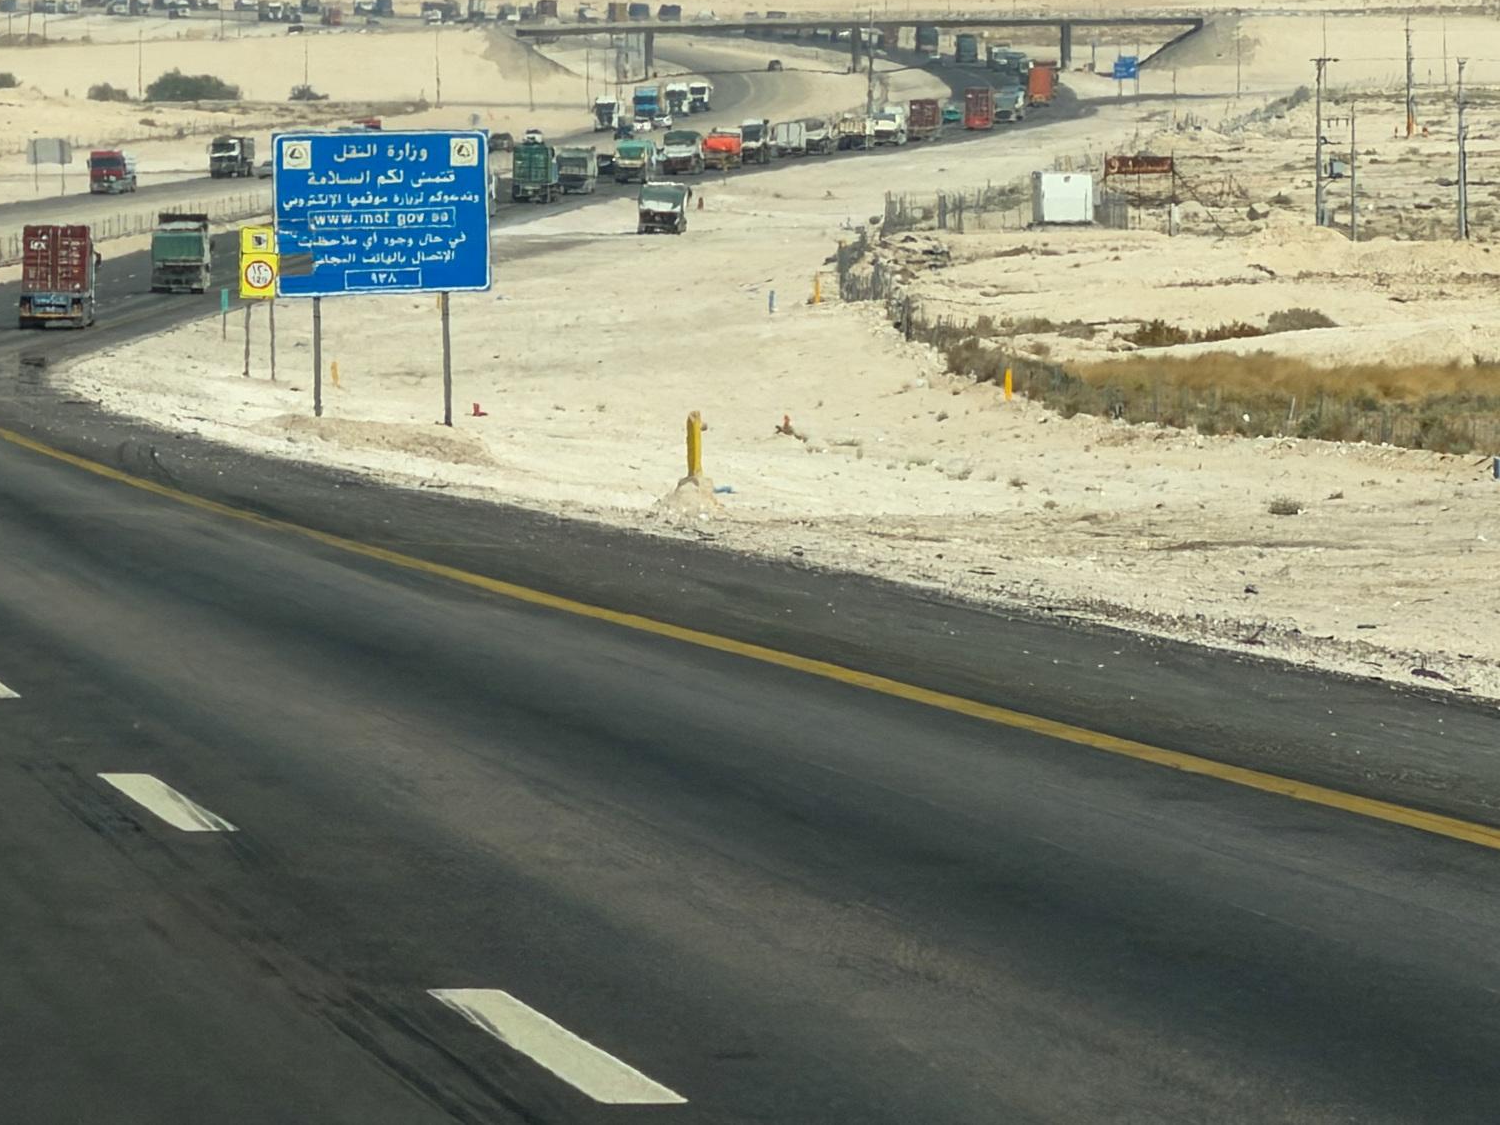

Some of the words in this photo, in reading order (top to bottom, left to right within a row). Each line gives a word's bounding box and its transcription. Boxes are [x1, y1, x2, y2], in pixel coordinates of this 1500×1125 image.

[333, 143, 378, 162] النقل
[387, 142, 428, 162] وزارة
[307, 169, 370, 185] السلامة
[376, 169, 404, 188] لكم
[314, 211, 449, 227] www.motgovsa
[384, 236, 414, 248] وجود
[419, 233, 443, 246] حال
[448, 231, 466, 249] في
[371, 272, 397, 284] ٩٣٨
